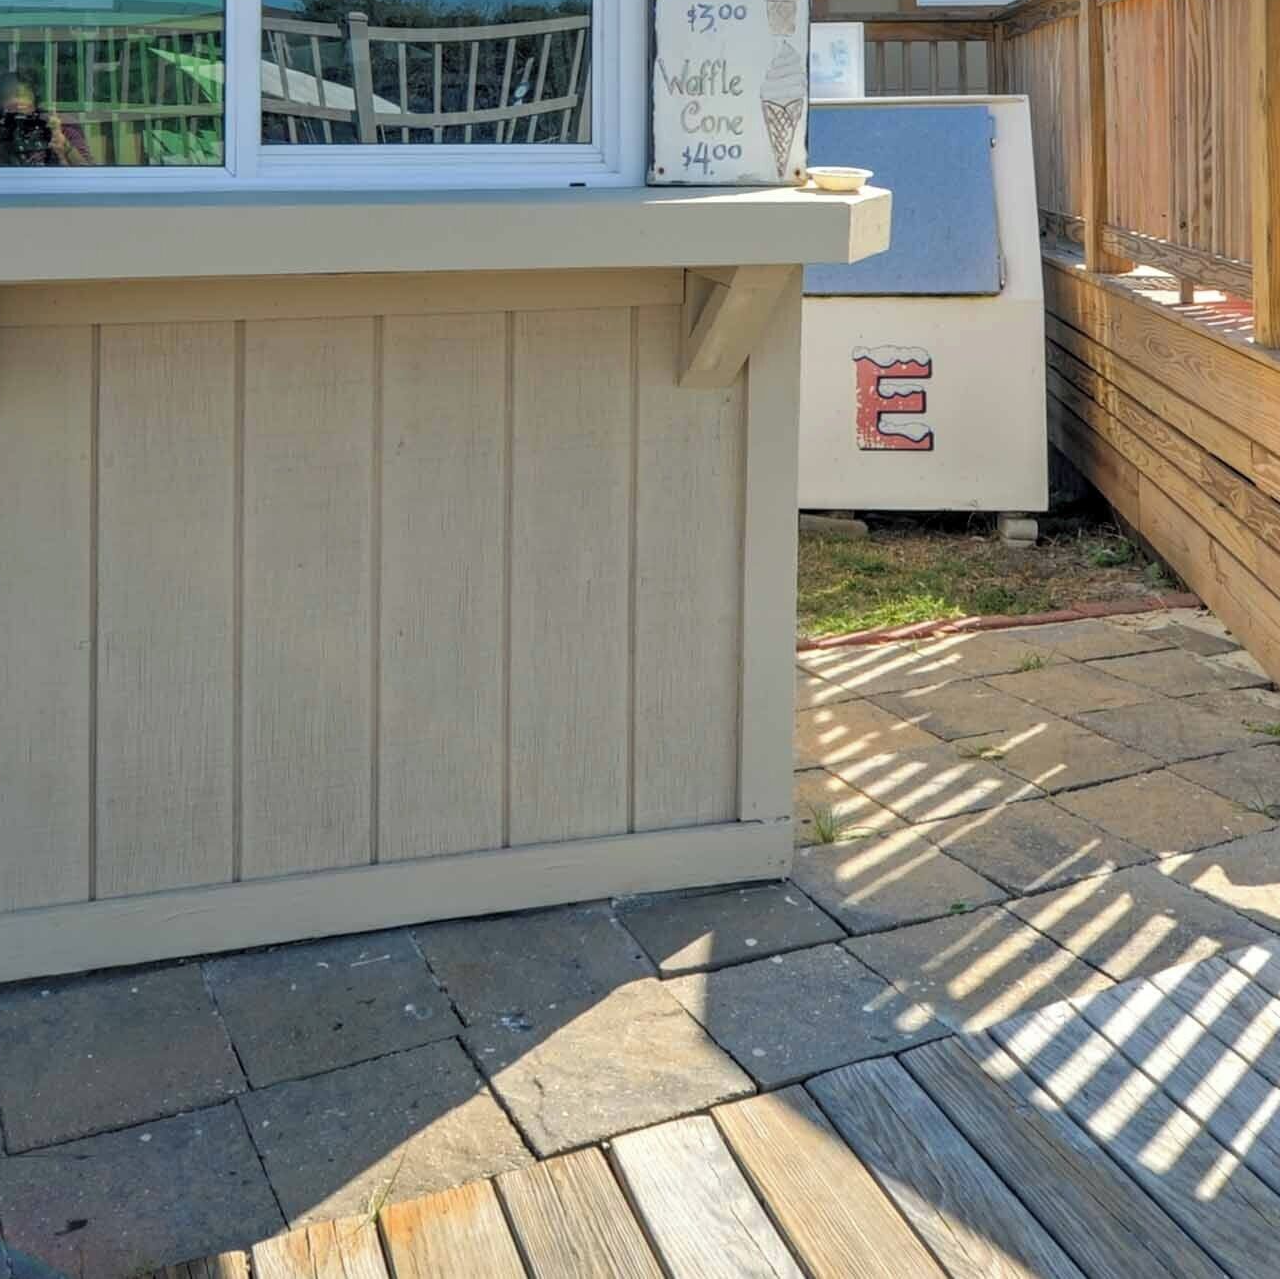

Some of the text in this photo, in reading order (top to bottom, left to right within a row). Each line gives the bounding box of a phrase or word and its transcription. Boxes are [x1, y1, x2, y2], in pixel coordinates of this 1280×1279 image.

[657, 57, 744, 97] Waffle
[680, 100, 744, 136] Cone
[852, 344, 934, 451] E
